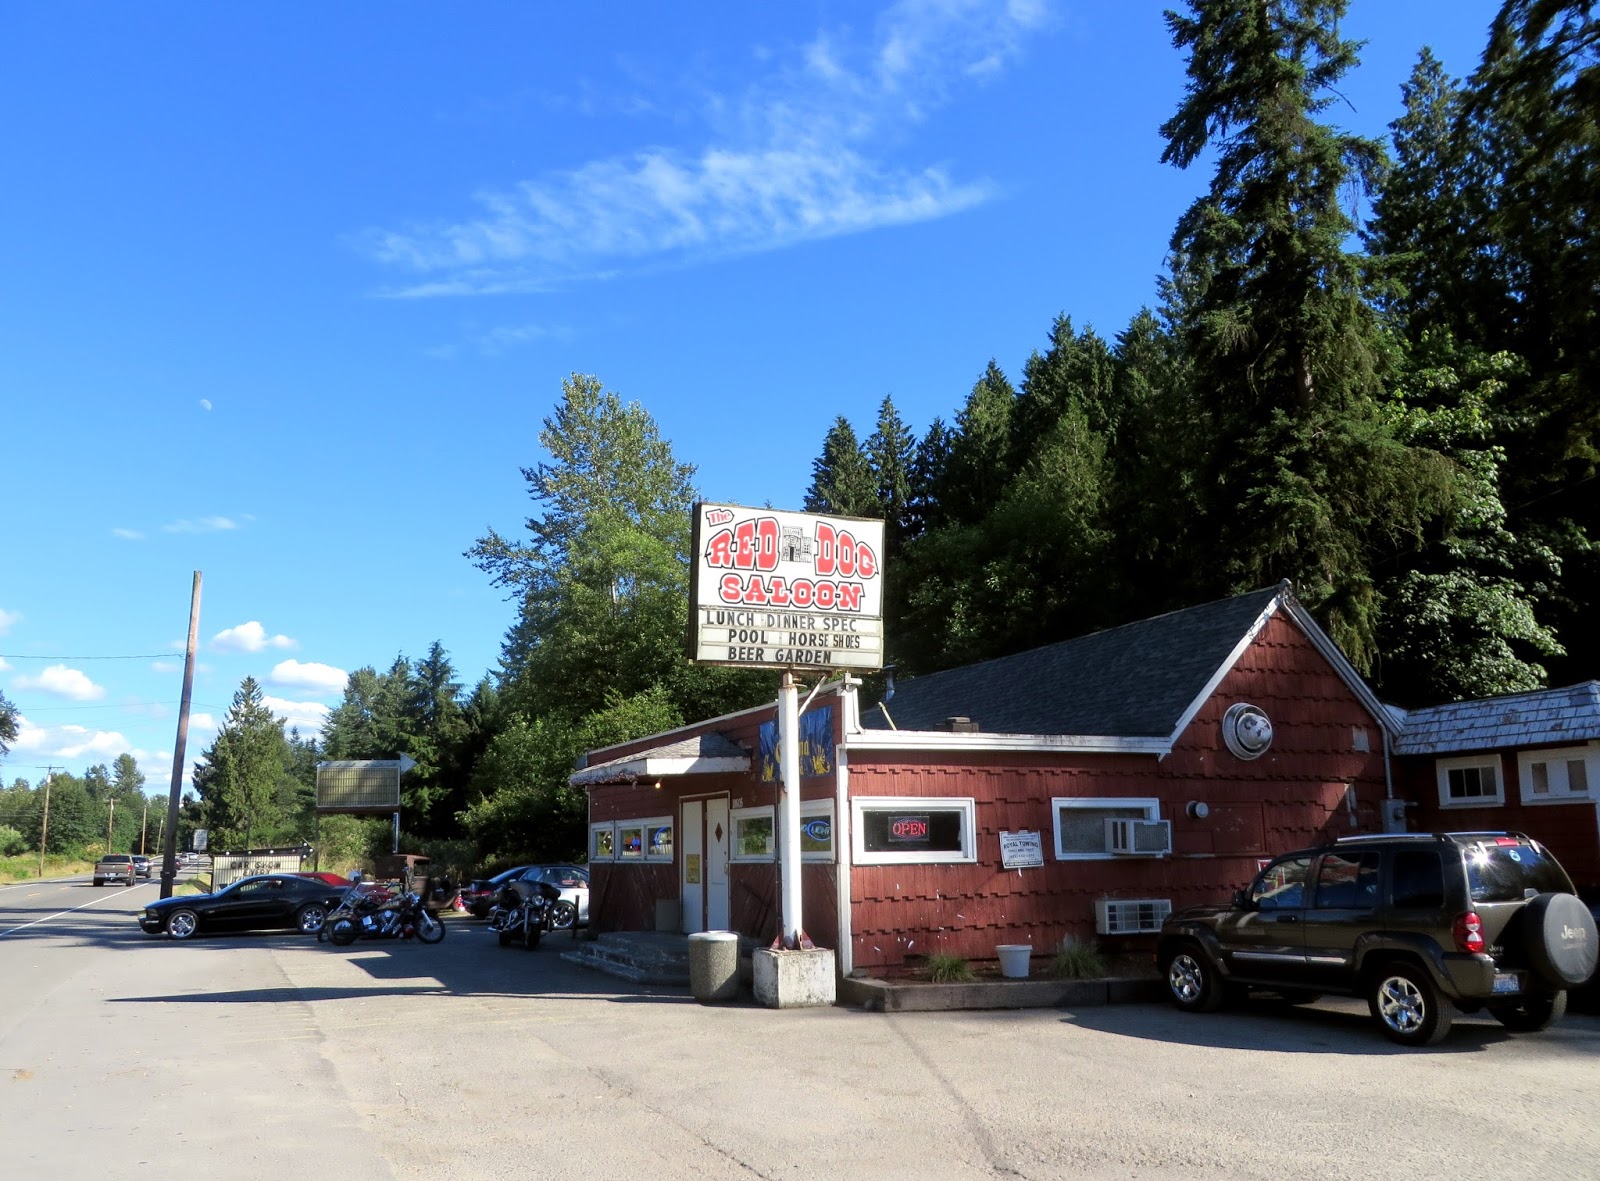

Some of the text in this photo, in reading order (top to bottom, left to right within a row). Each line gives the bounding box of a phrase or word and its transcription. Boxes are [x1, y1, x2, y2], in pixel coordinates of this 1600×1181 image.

[708, 511, 732, 526] The
[705, 518, 878, 579] RED DOG
[719, 573, 864, 611] SALOON
[706, 610, 857, 632] LUNCH DINNER SPEC
[728, 628, 768, 644] POOL
[789, 632, 829, 647] HORSE
[728, 645, 831, 664] BEER GARDEN
[892, 822, 927, 836] OPEN
[230, 861, 250, 869] CAR
[1560, 925, 1586, 940] Jeep
